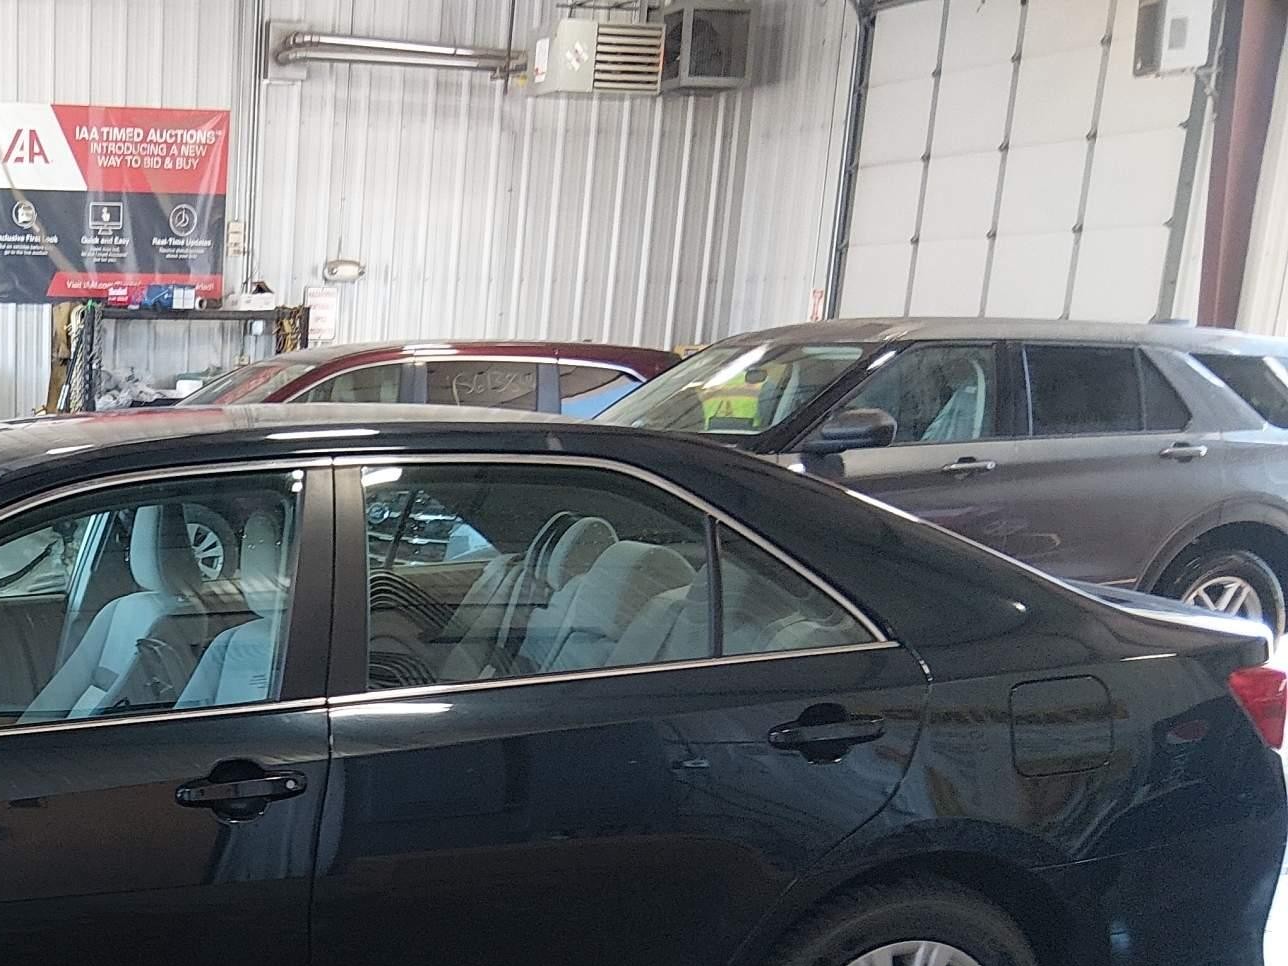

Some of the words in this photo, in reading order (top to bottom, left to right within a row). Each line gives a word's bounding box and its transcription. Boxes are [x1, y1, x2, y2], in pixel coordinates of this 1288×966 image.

[75, 126, 99, 141] IAA
[100, 126, 143, 142] TIMED
[90, 142, 166, 156] INTRODUCING
[169, 145, 178, 156] A
[180, 145, 207, 157] NEW
[98, 155, 123, 168] WAY
[125, 155, 141, 168] TO
[143, 156, 161, 169] BID
[164, 157, 173, 169] &
[176, 158, 199, 170] BUY
